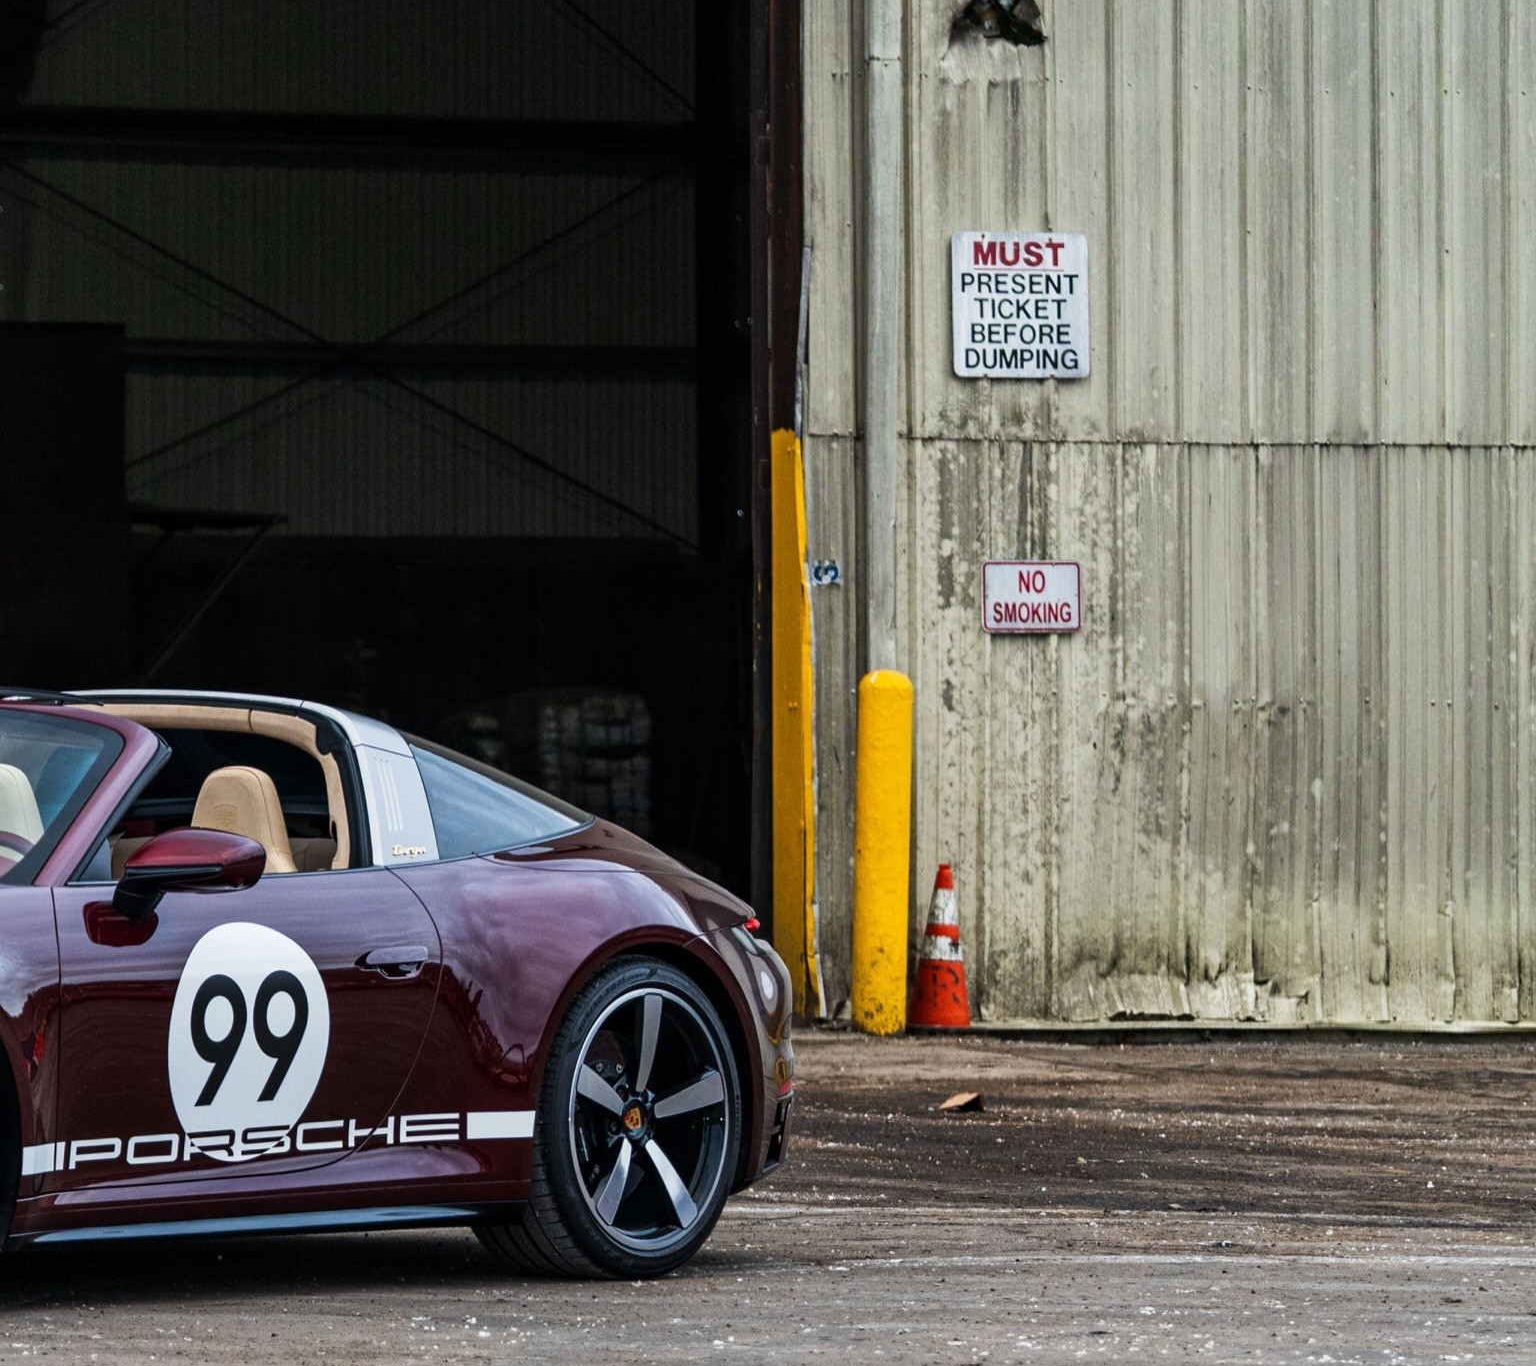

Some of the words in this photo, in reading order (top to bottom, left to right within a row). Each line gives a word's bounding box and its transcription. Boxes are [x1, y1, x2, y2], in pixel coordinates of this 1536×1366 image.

[973, 241, 1065, 267] MUST
[961, 272, 1079, 295] PRESENT
[974, 297, 1067, 320] TICKET
[970, 323, 1071, 345] BEFORE
[965, 348, 1079, 370] DUMPING
[1018, 570, 1046, 594] NO
[993, 602, 1072, 624] SMOKING
[190, 969, 309, 1107] 99
[68, 1112, 460, 1170] PORSCHE
